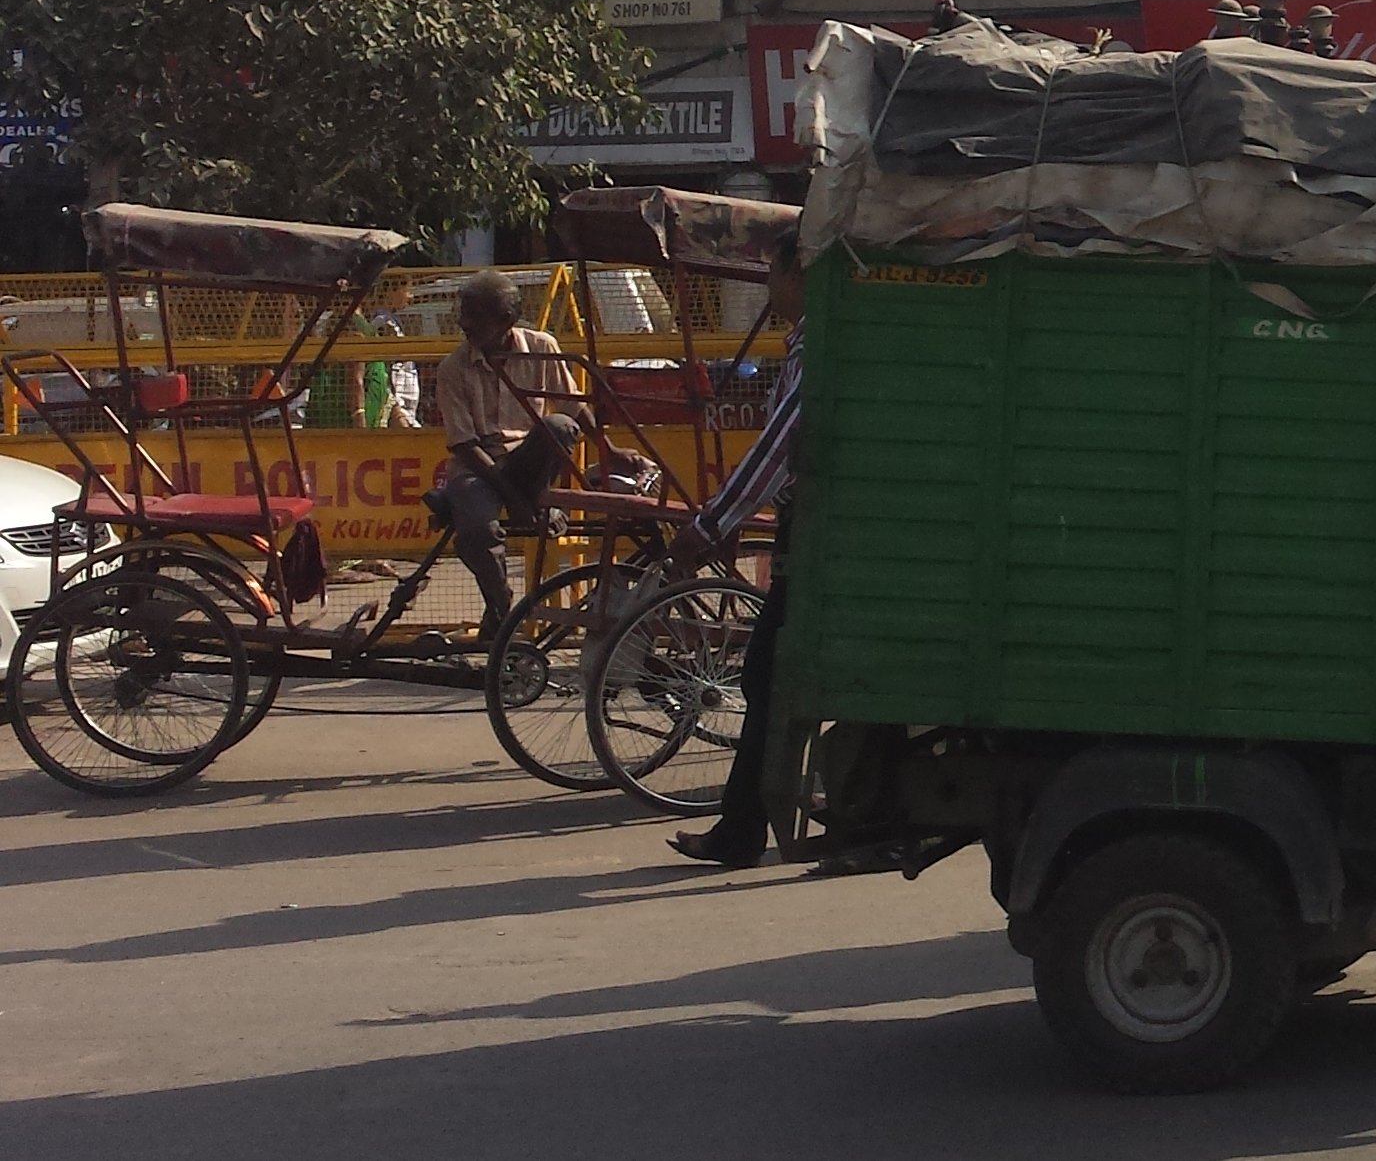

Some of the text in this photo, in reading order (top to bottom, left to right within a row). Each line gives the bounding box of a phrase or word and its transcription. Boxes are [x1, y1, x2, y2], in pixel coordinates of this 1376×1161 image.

[611, 3, 649, 19] SHOP
[672, 0, 691, 16] 761
[1253, 320, 1328, 339] CNG
[233, 457, 424, 509] POLICE
